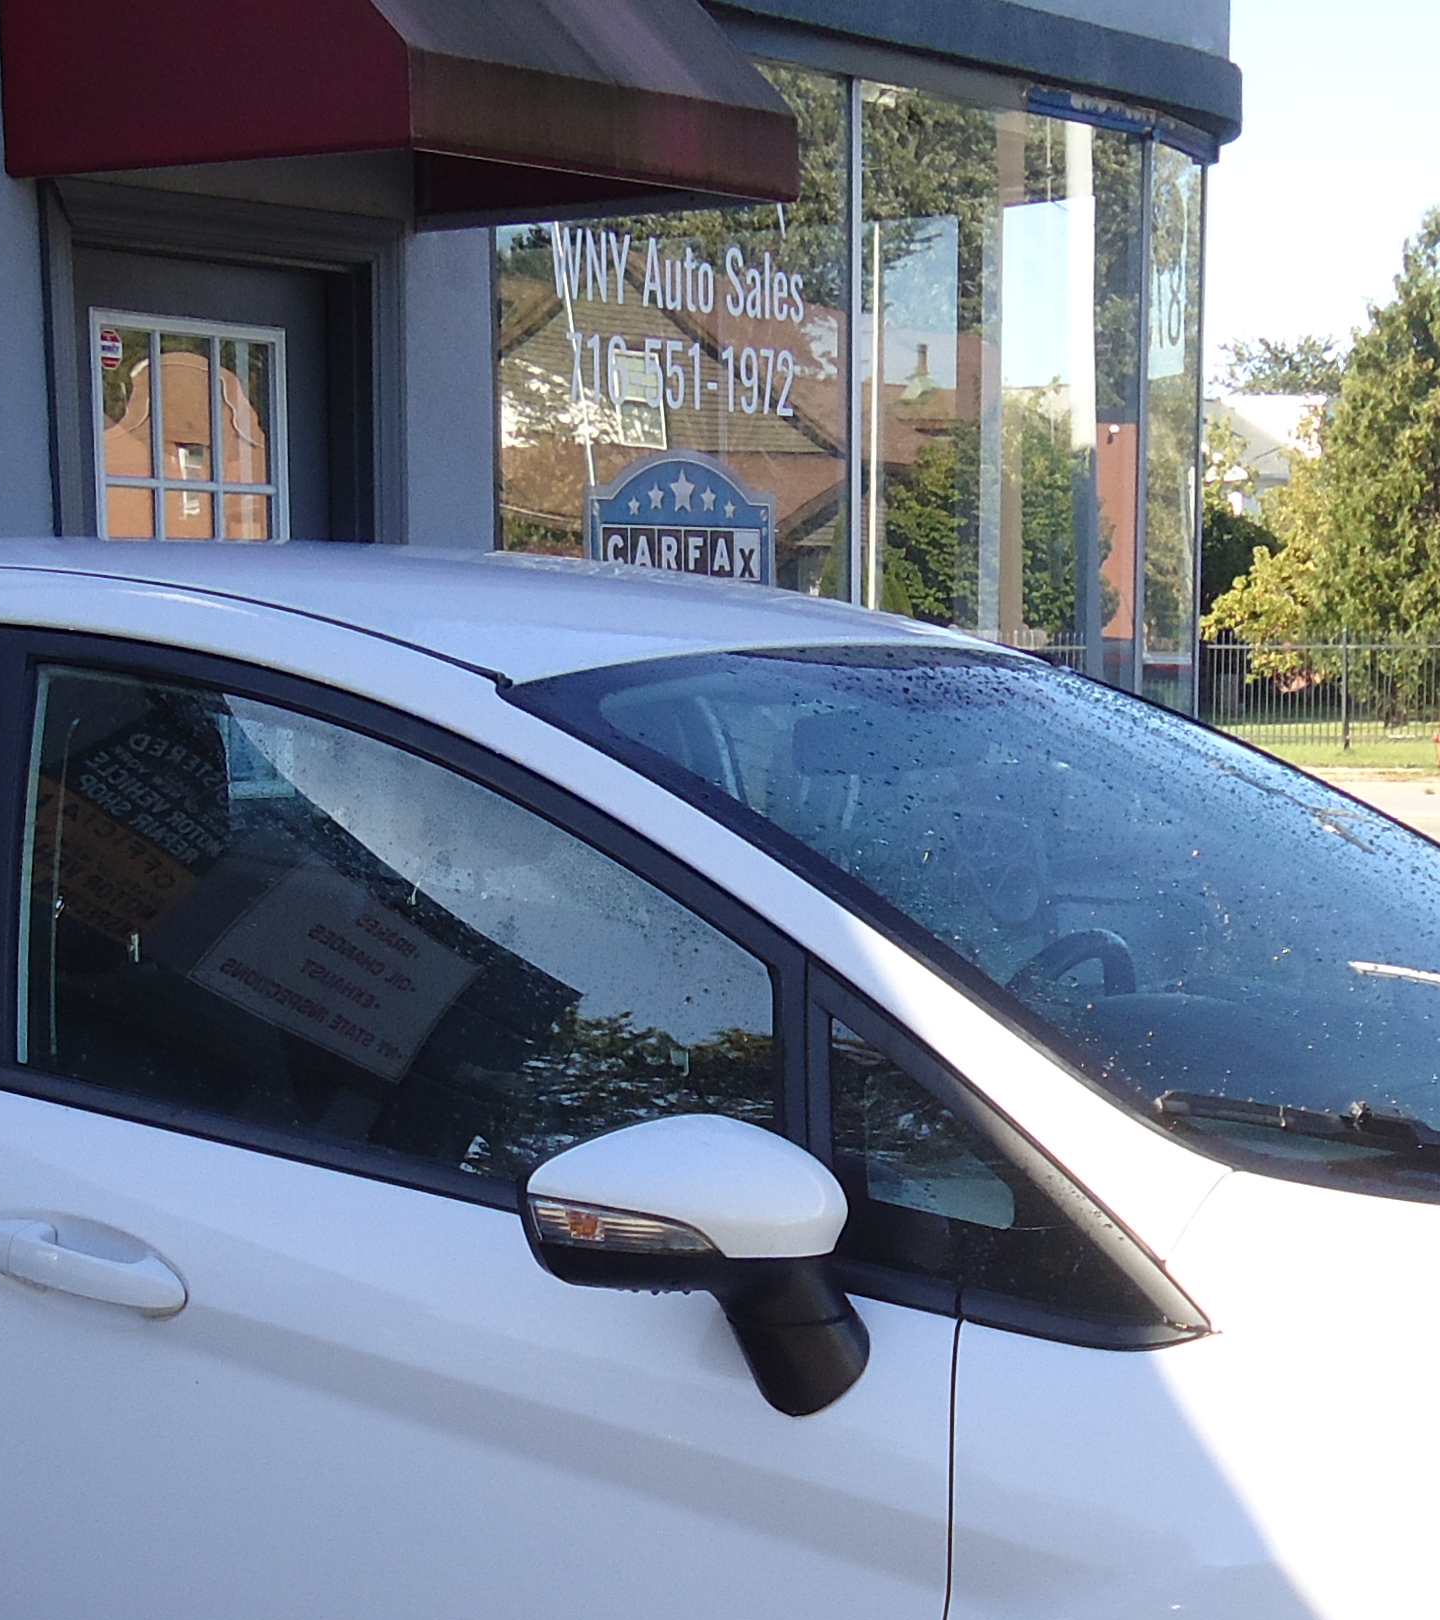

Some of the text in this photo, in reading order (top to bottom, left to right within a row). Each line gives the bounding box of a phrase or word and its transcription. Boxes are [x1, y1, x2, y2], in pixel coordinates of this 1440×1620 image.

[551, 224, 805, 321] WNY Auto Sales
[607, 534, 755, 578] CARFAX
